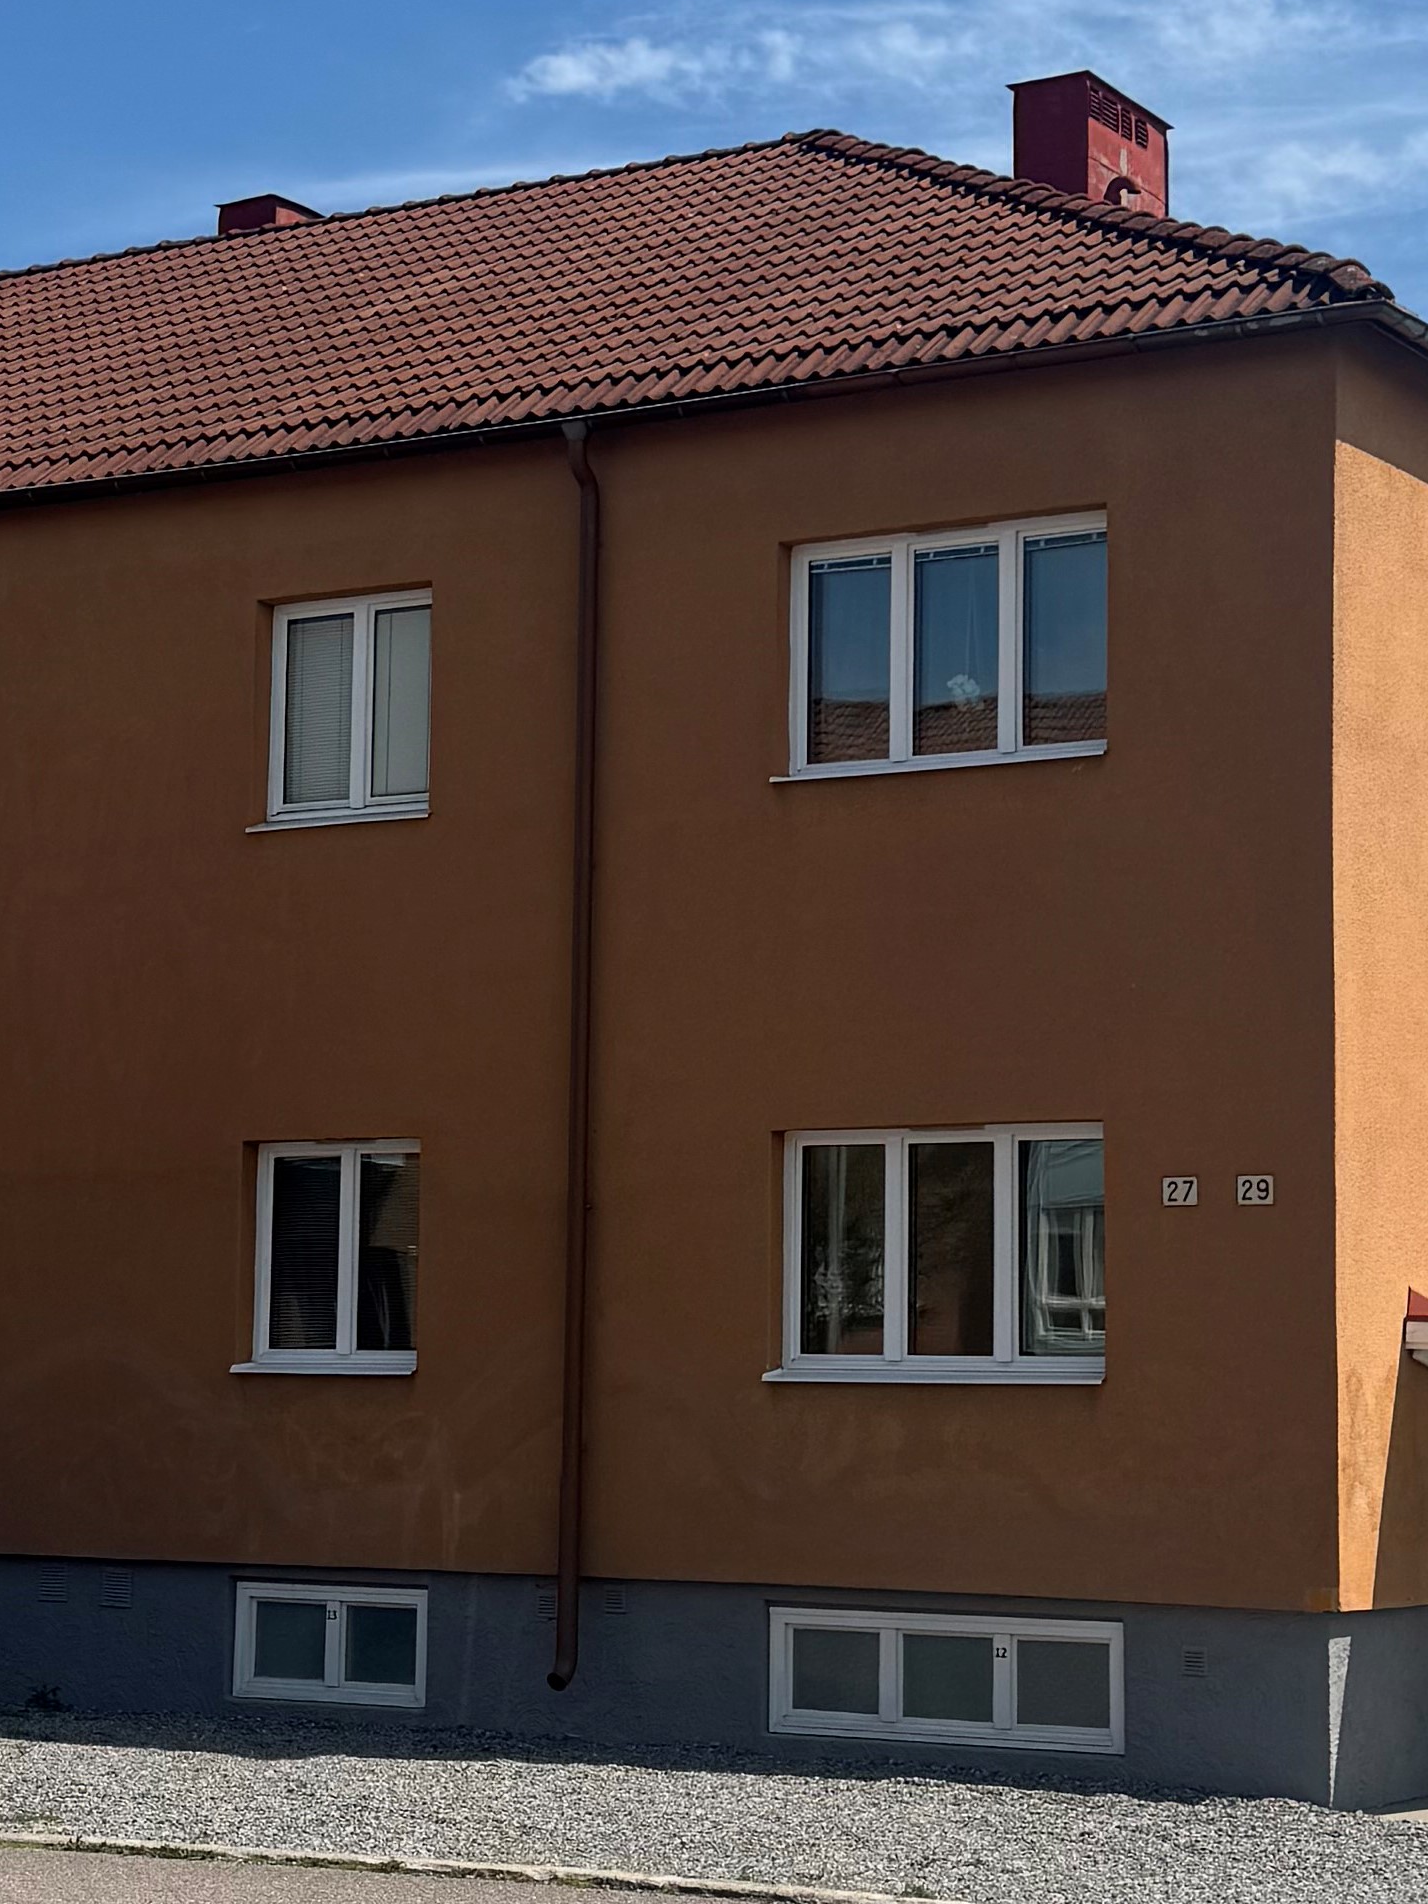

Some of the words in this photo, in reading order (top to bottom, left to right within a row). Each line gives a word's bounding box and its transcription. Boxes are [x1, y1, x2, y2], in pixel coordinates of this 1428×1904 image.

[1166, 1179, 1195, 1203] 27
[1240, 1178, 1270, 1201] 29
[995, 1647, 1008, 1658] 12
